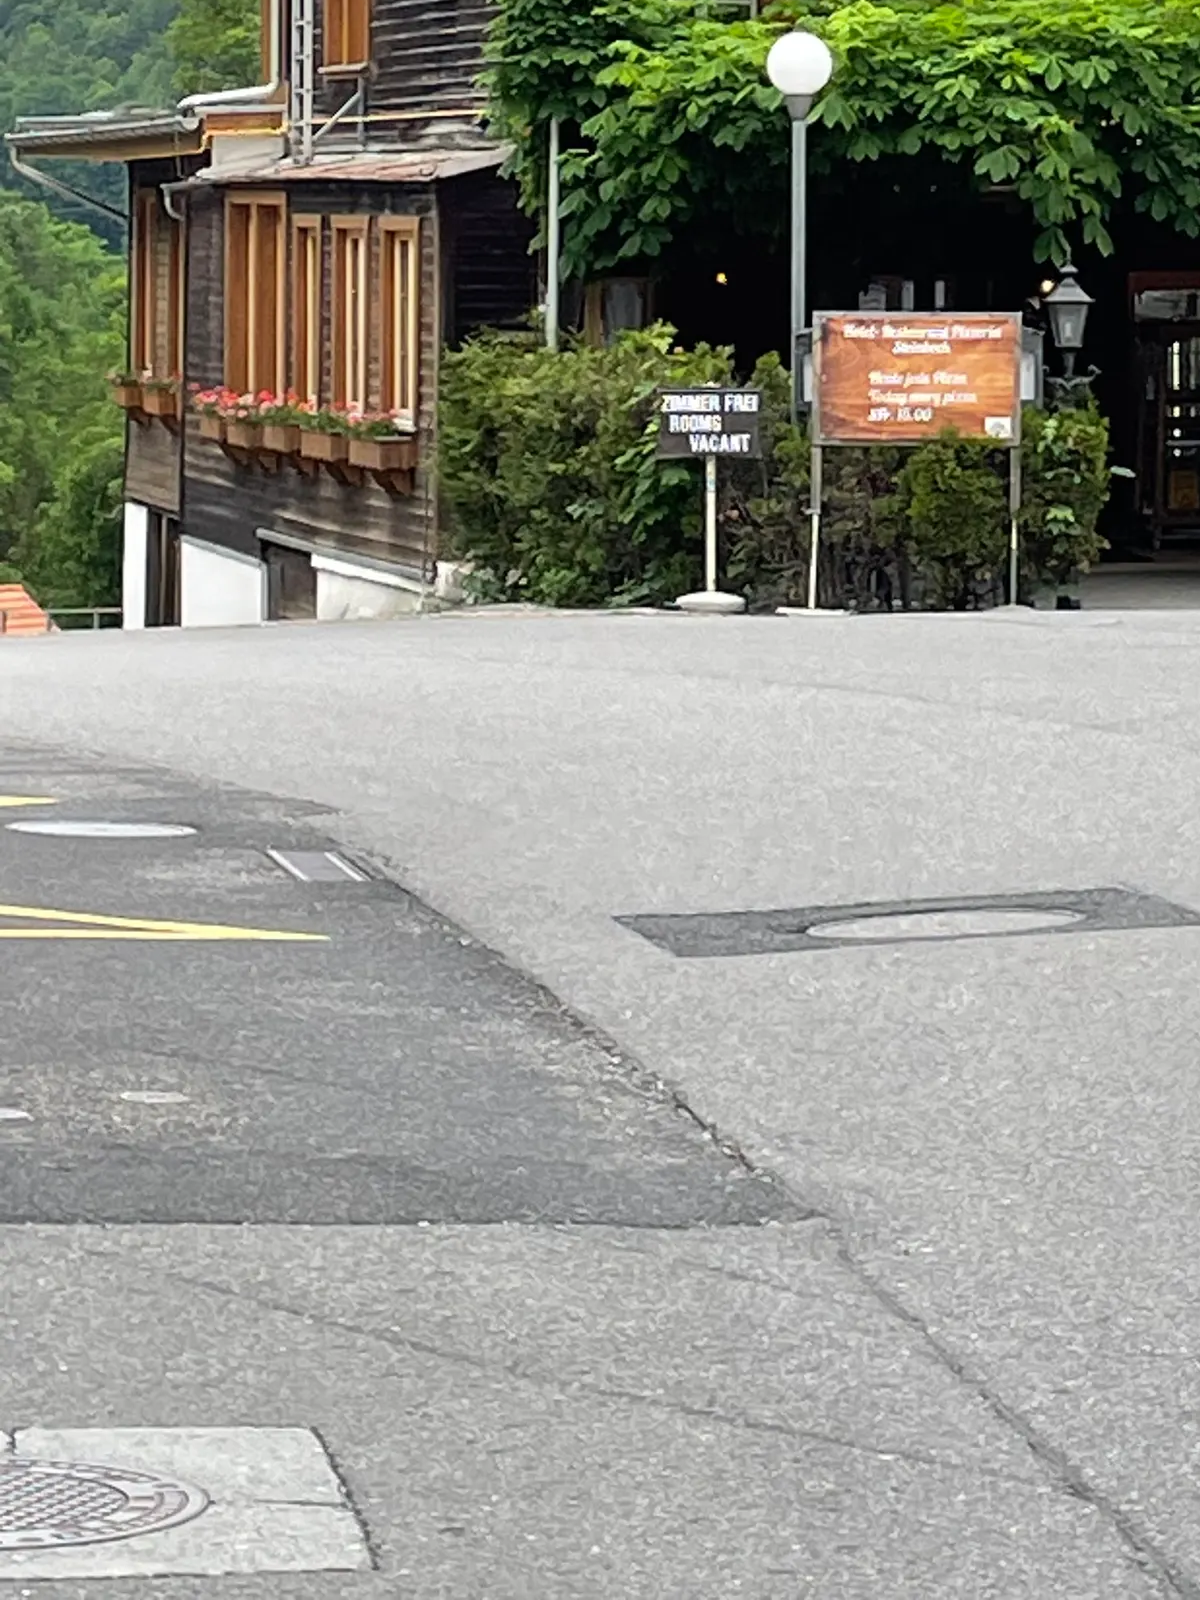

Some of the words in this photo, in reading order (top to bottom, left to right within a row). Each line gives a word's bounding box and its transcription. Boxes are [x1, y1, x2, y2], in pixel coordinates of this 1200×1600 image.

[724, 393, 759, 412] FREI
[669, 414, 722, 433] ROOMS
[689, 433, 751, 453] VACANT
